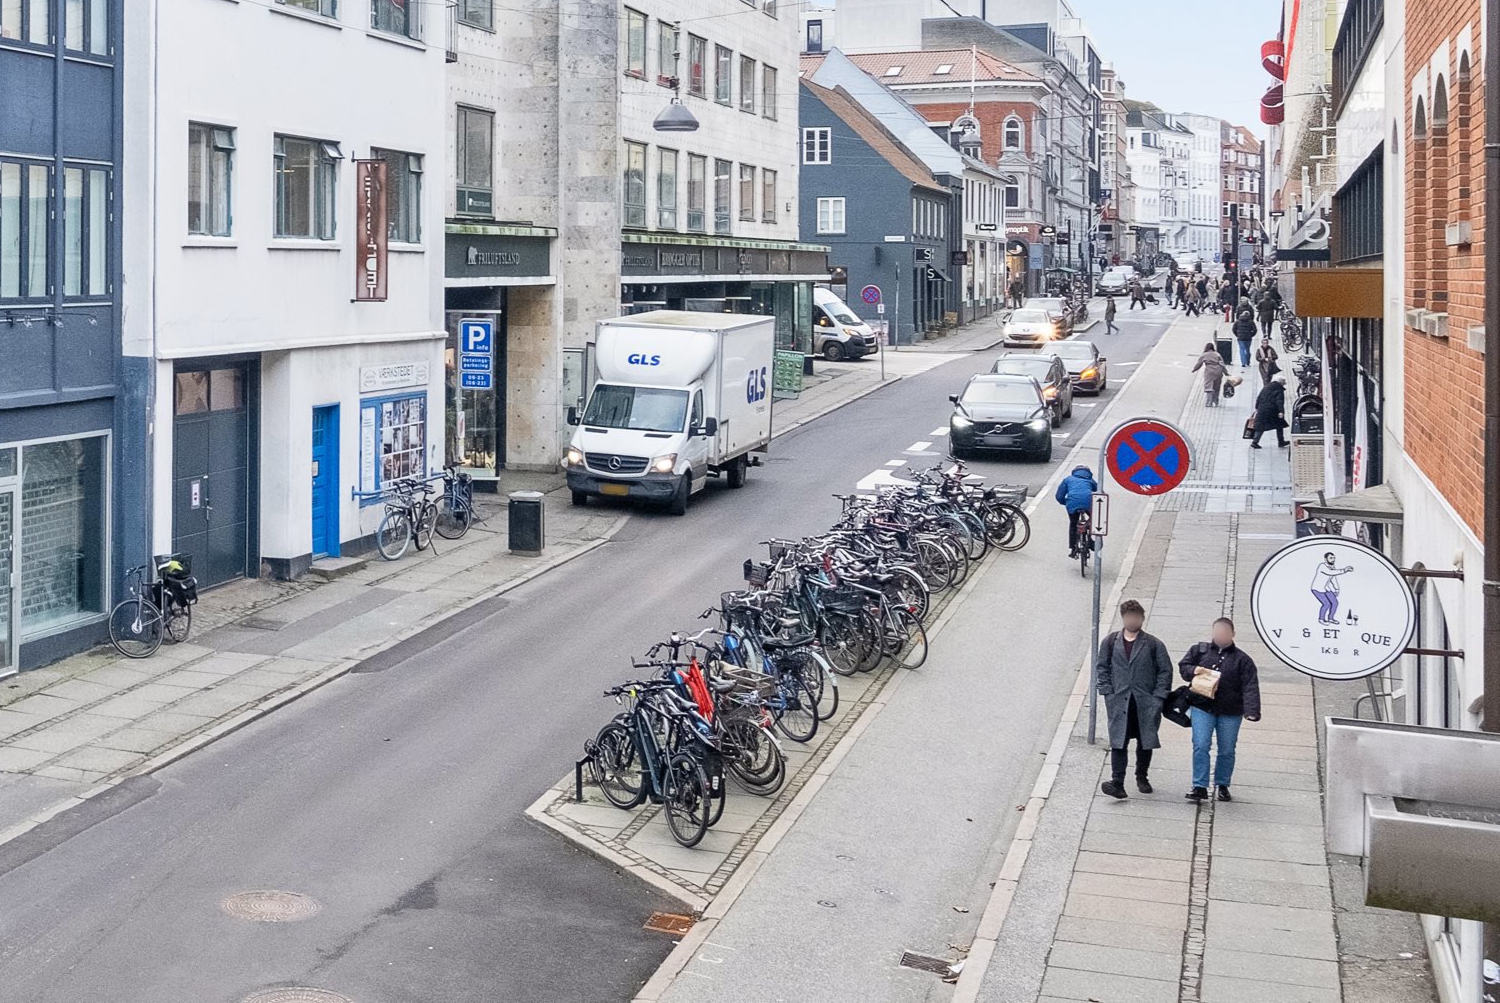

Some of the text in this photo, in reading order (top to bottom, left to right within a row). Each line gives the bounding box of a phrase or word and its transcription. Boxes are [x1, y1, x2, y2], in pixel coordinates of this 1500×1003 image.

[1005, 226, 1029, 234] ynoptik
[478, 252, 520, 265] FRILUFTSLAND
[468, 325, 486, 350] P
[627, 353, 661, 366] GLS
[746, 366, 766, 404] GLS
